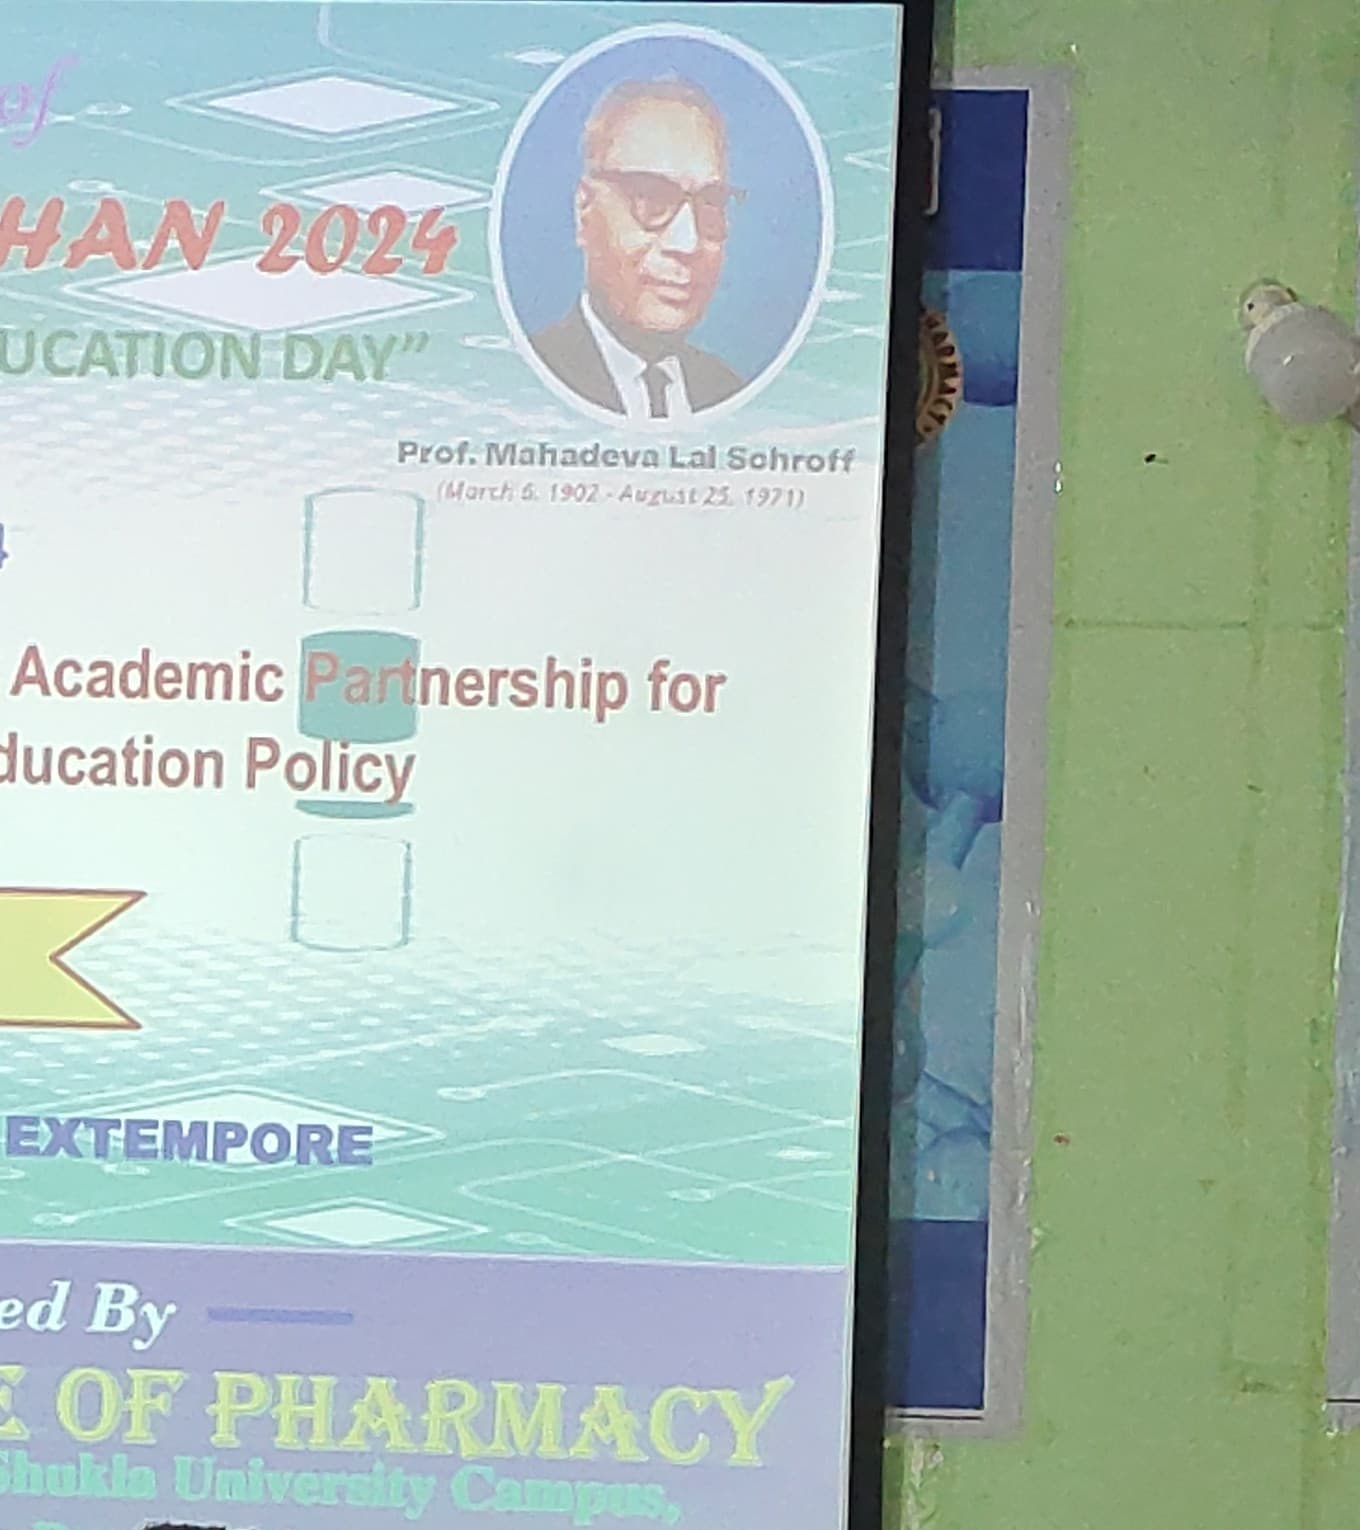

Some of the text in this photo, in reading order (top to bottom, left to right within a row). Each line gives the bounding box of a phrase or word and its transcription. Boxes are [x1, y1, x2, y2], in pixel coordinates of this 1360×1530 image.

[255, 204, 459, 276] 2024
[283, 330, 430, 382] DAY”
[398, 441, 856, 473] Prof. Mahadeva Lal Schroff
[438, 480, 513, 502] (March
[550, 483, 600, 503] 1902
[618, 485, 696, 506] August
[11, 645, 283, 702] Academic
[305, 651, 629, 722] Partnership
[649, 658, 726, 713] for
[247, 738, 415, 806] Policy
[5, 1115, 375, 1166] EXTEMPORE
[87, 1281, 177, 1350] By
[56, 1367, 185, 1445] OF
[210, 1370, 795, 1468] PHARMACY
[174, 1458, 435, 1519] University
[452, 1466, 682, 1527] Campus,
